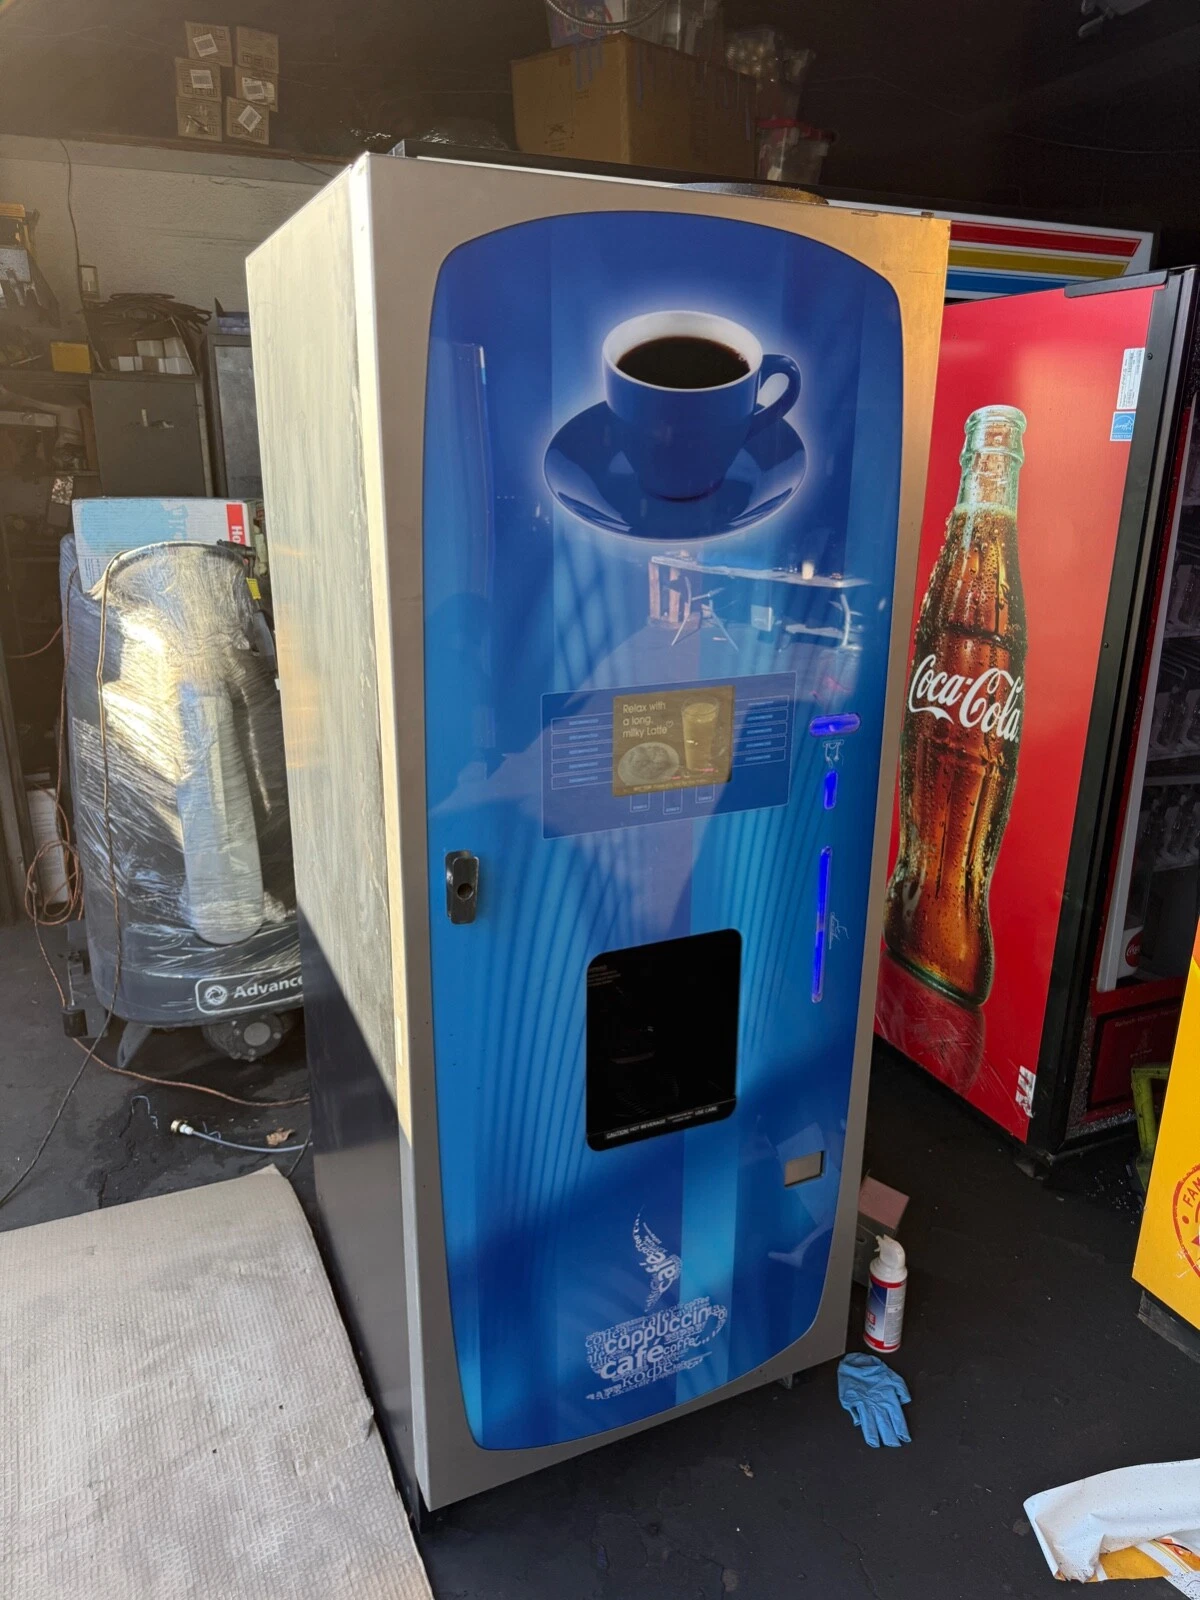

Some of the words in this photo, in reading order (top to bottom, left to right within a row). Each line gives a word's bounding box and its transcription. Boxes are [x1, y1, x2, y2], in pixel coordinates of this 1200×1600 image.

[623, 704, 647, 713] Relax
[649, 700, 666, 711] with
[908, 654, 1023, 742] Coca-Cola
[623, 728, 645, 739] milky
[646, 725, 668, 736] Latte
[600, 1338, 664, 1379] café
